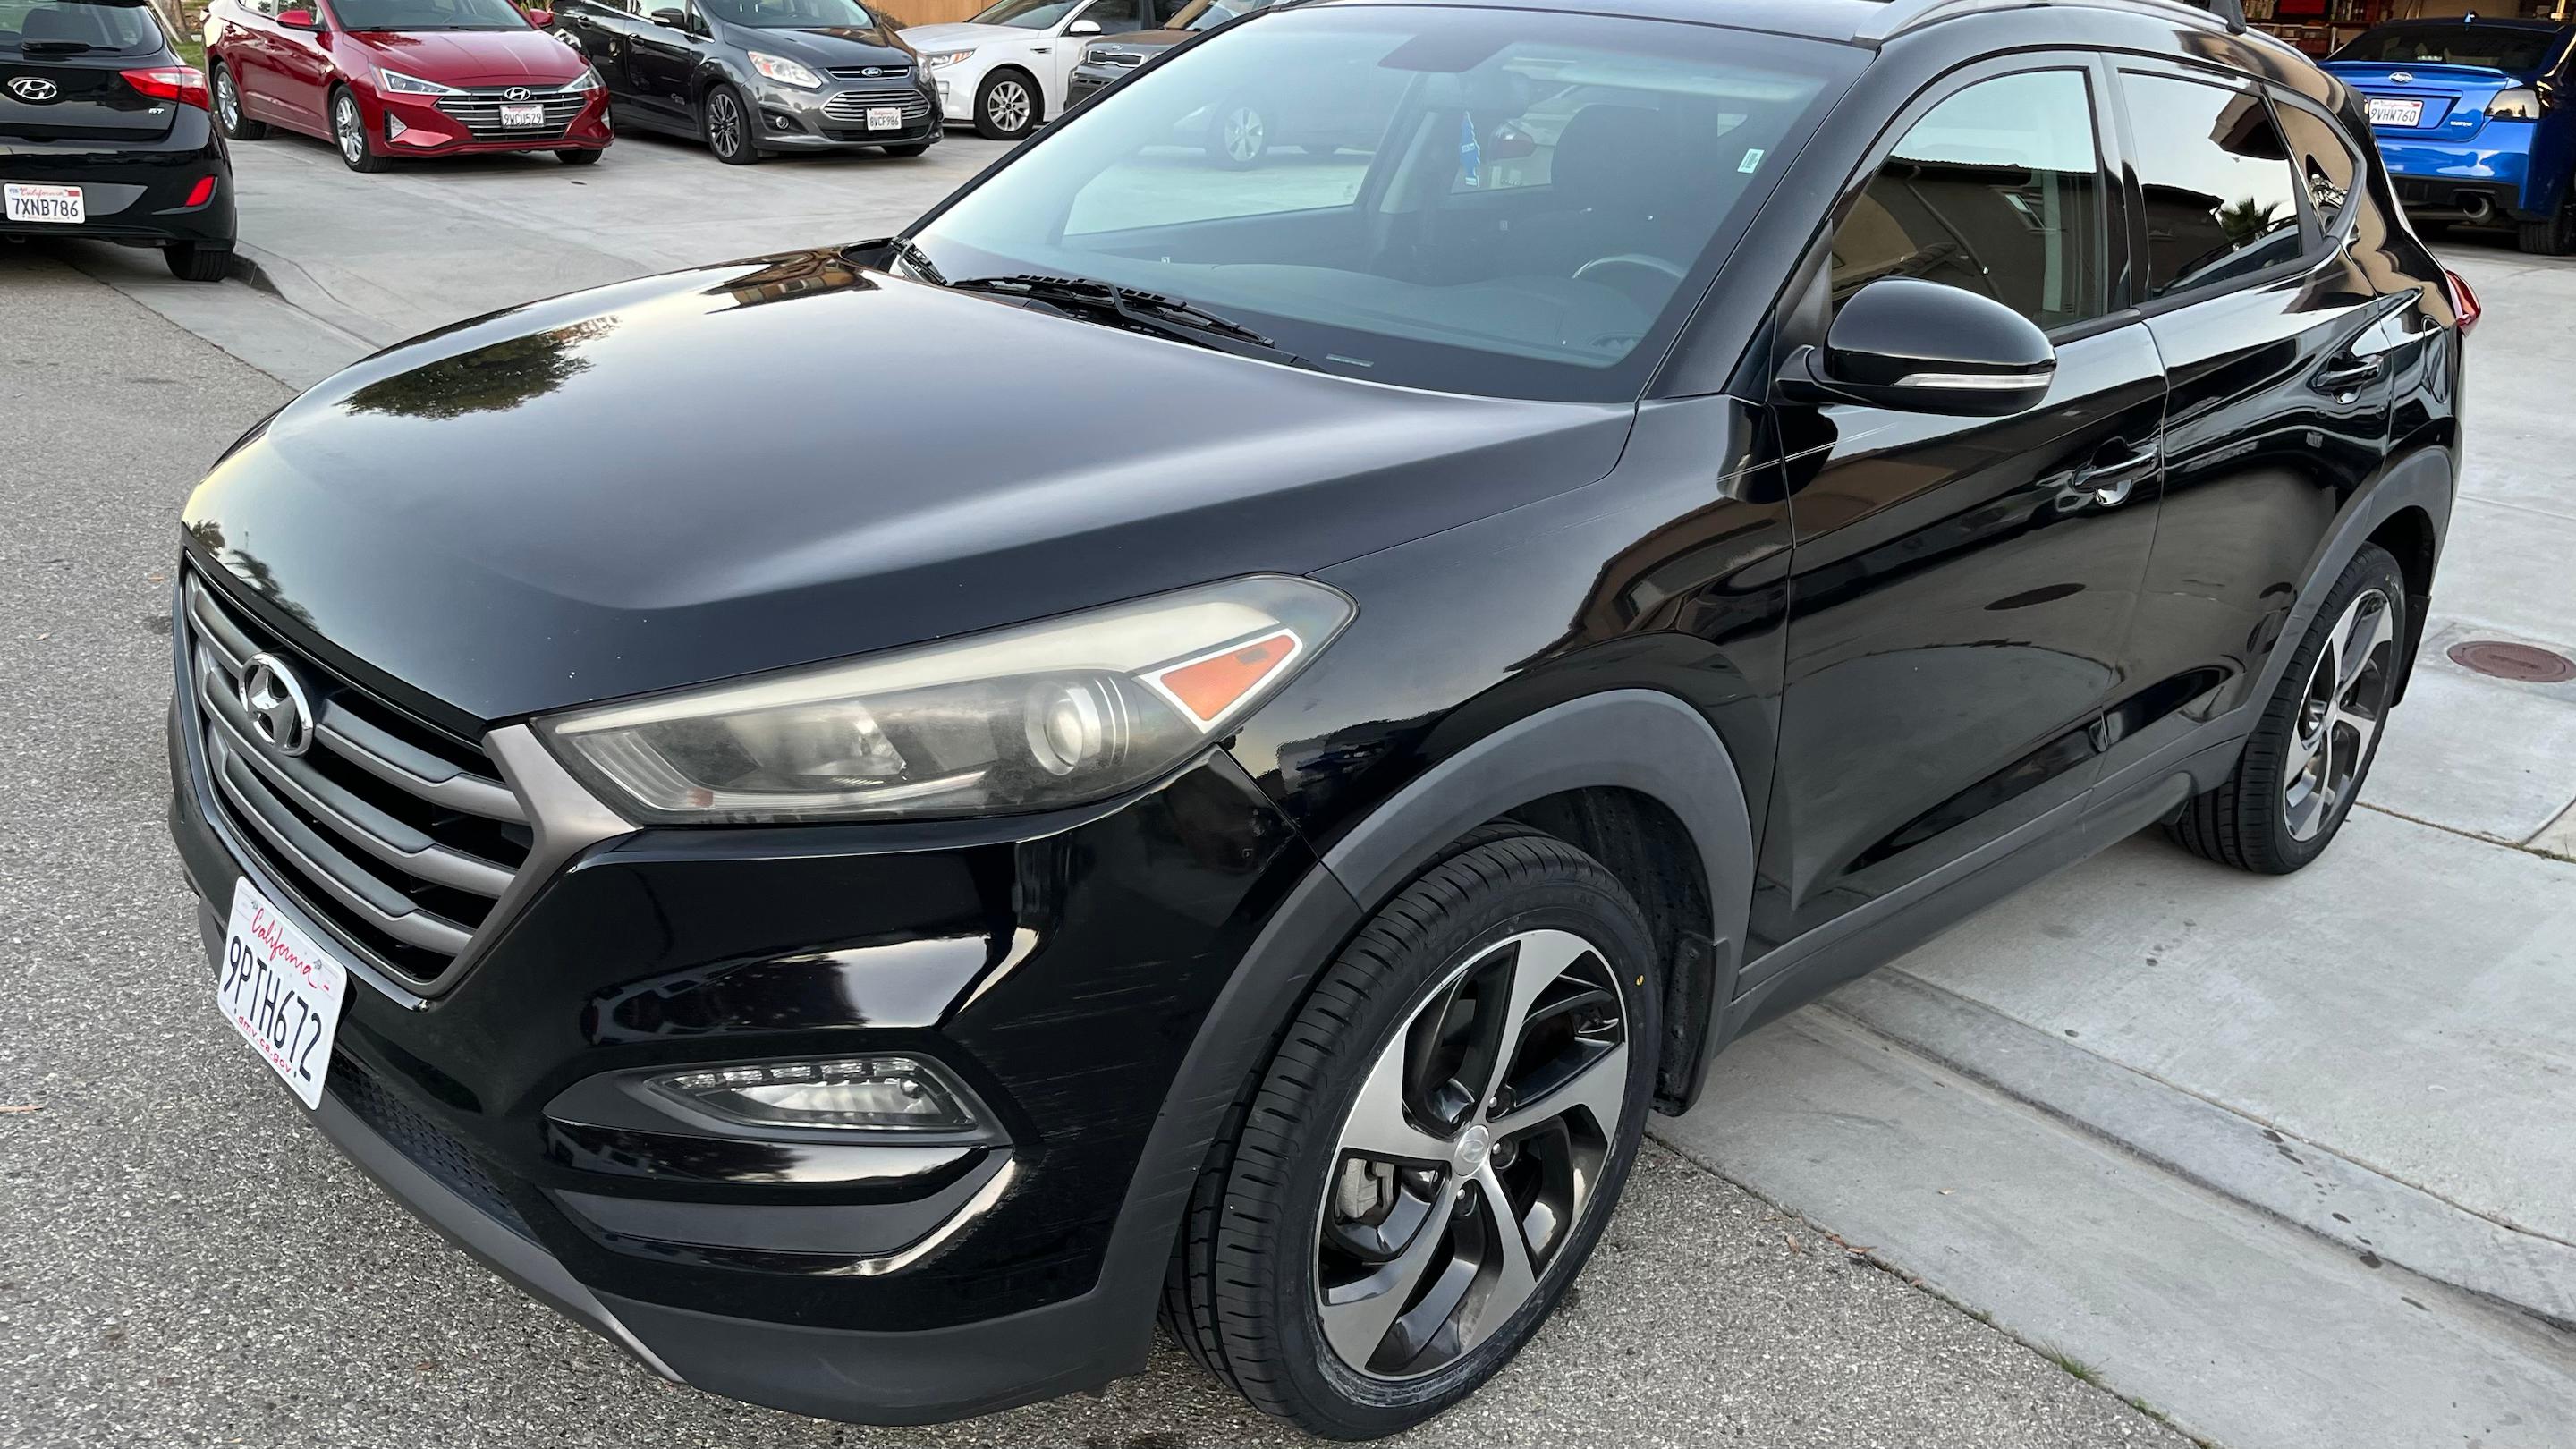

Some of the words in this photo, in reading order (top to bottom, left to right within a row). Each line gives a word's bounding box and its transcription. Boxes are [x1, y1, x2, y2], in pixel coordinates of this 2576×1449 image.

[2369, 107, 2416, 123] 9VHW760
[11, 197, 80, 217] 7XNB786
[250, 907, 318, 989] California
[223, 935, 323, 1083] 9PTH672
[238, 1014, 292, 1073] dmv.ca.gov
